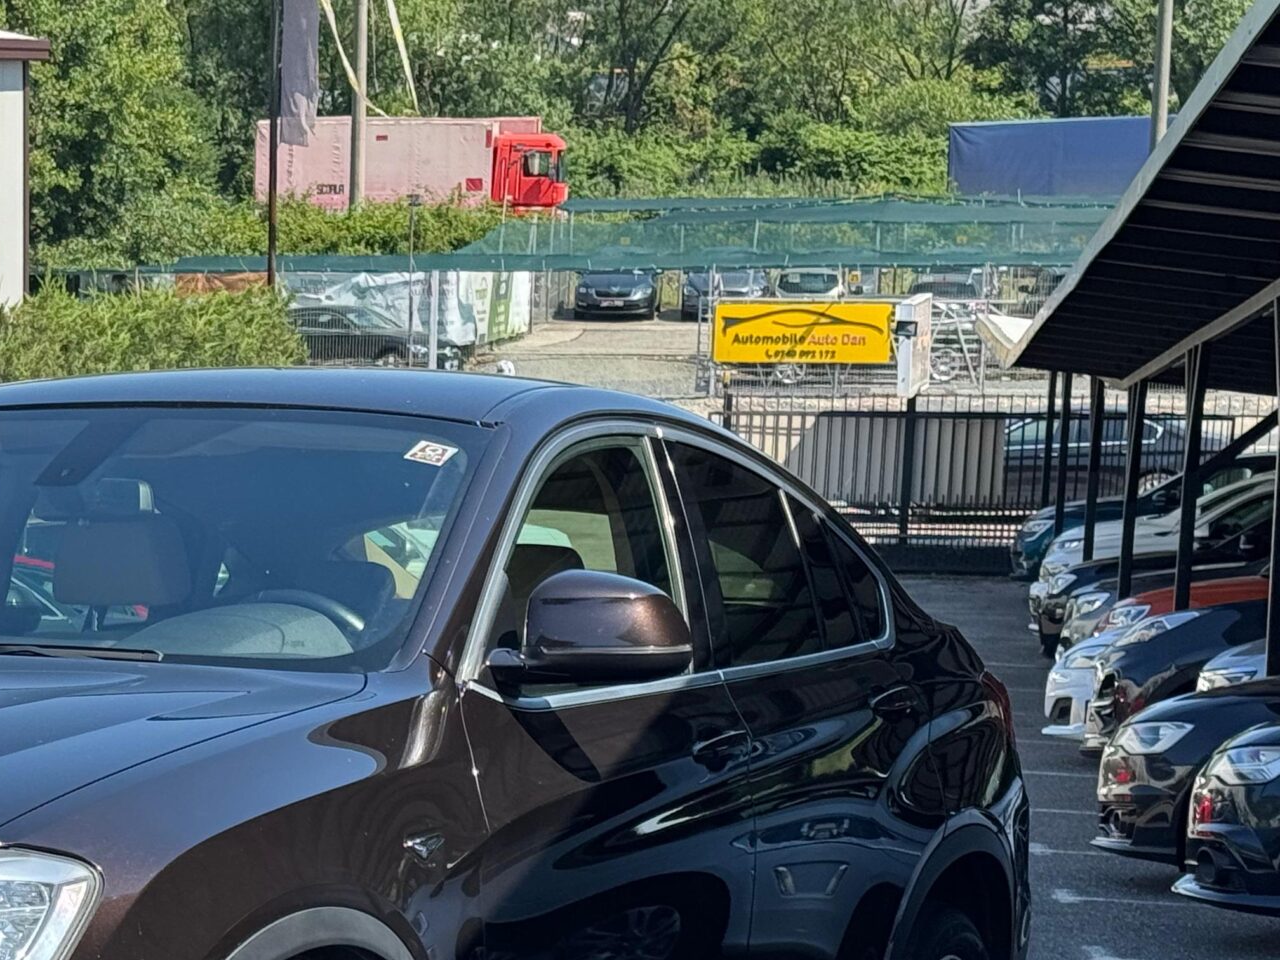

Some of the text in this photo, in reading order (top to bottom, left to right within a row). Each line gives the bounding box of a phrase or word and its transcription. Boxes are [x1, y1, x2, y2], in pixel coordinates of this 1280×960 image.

[732, 332, 866, 346] Automobile Auto Dan
